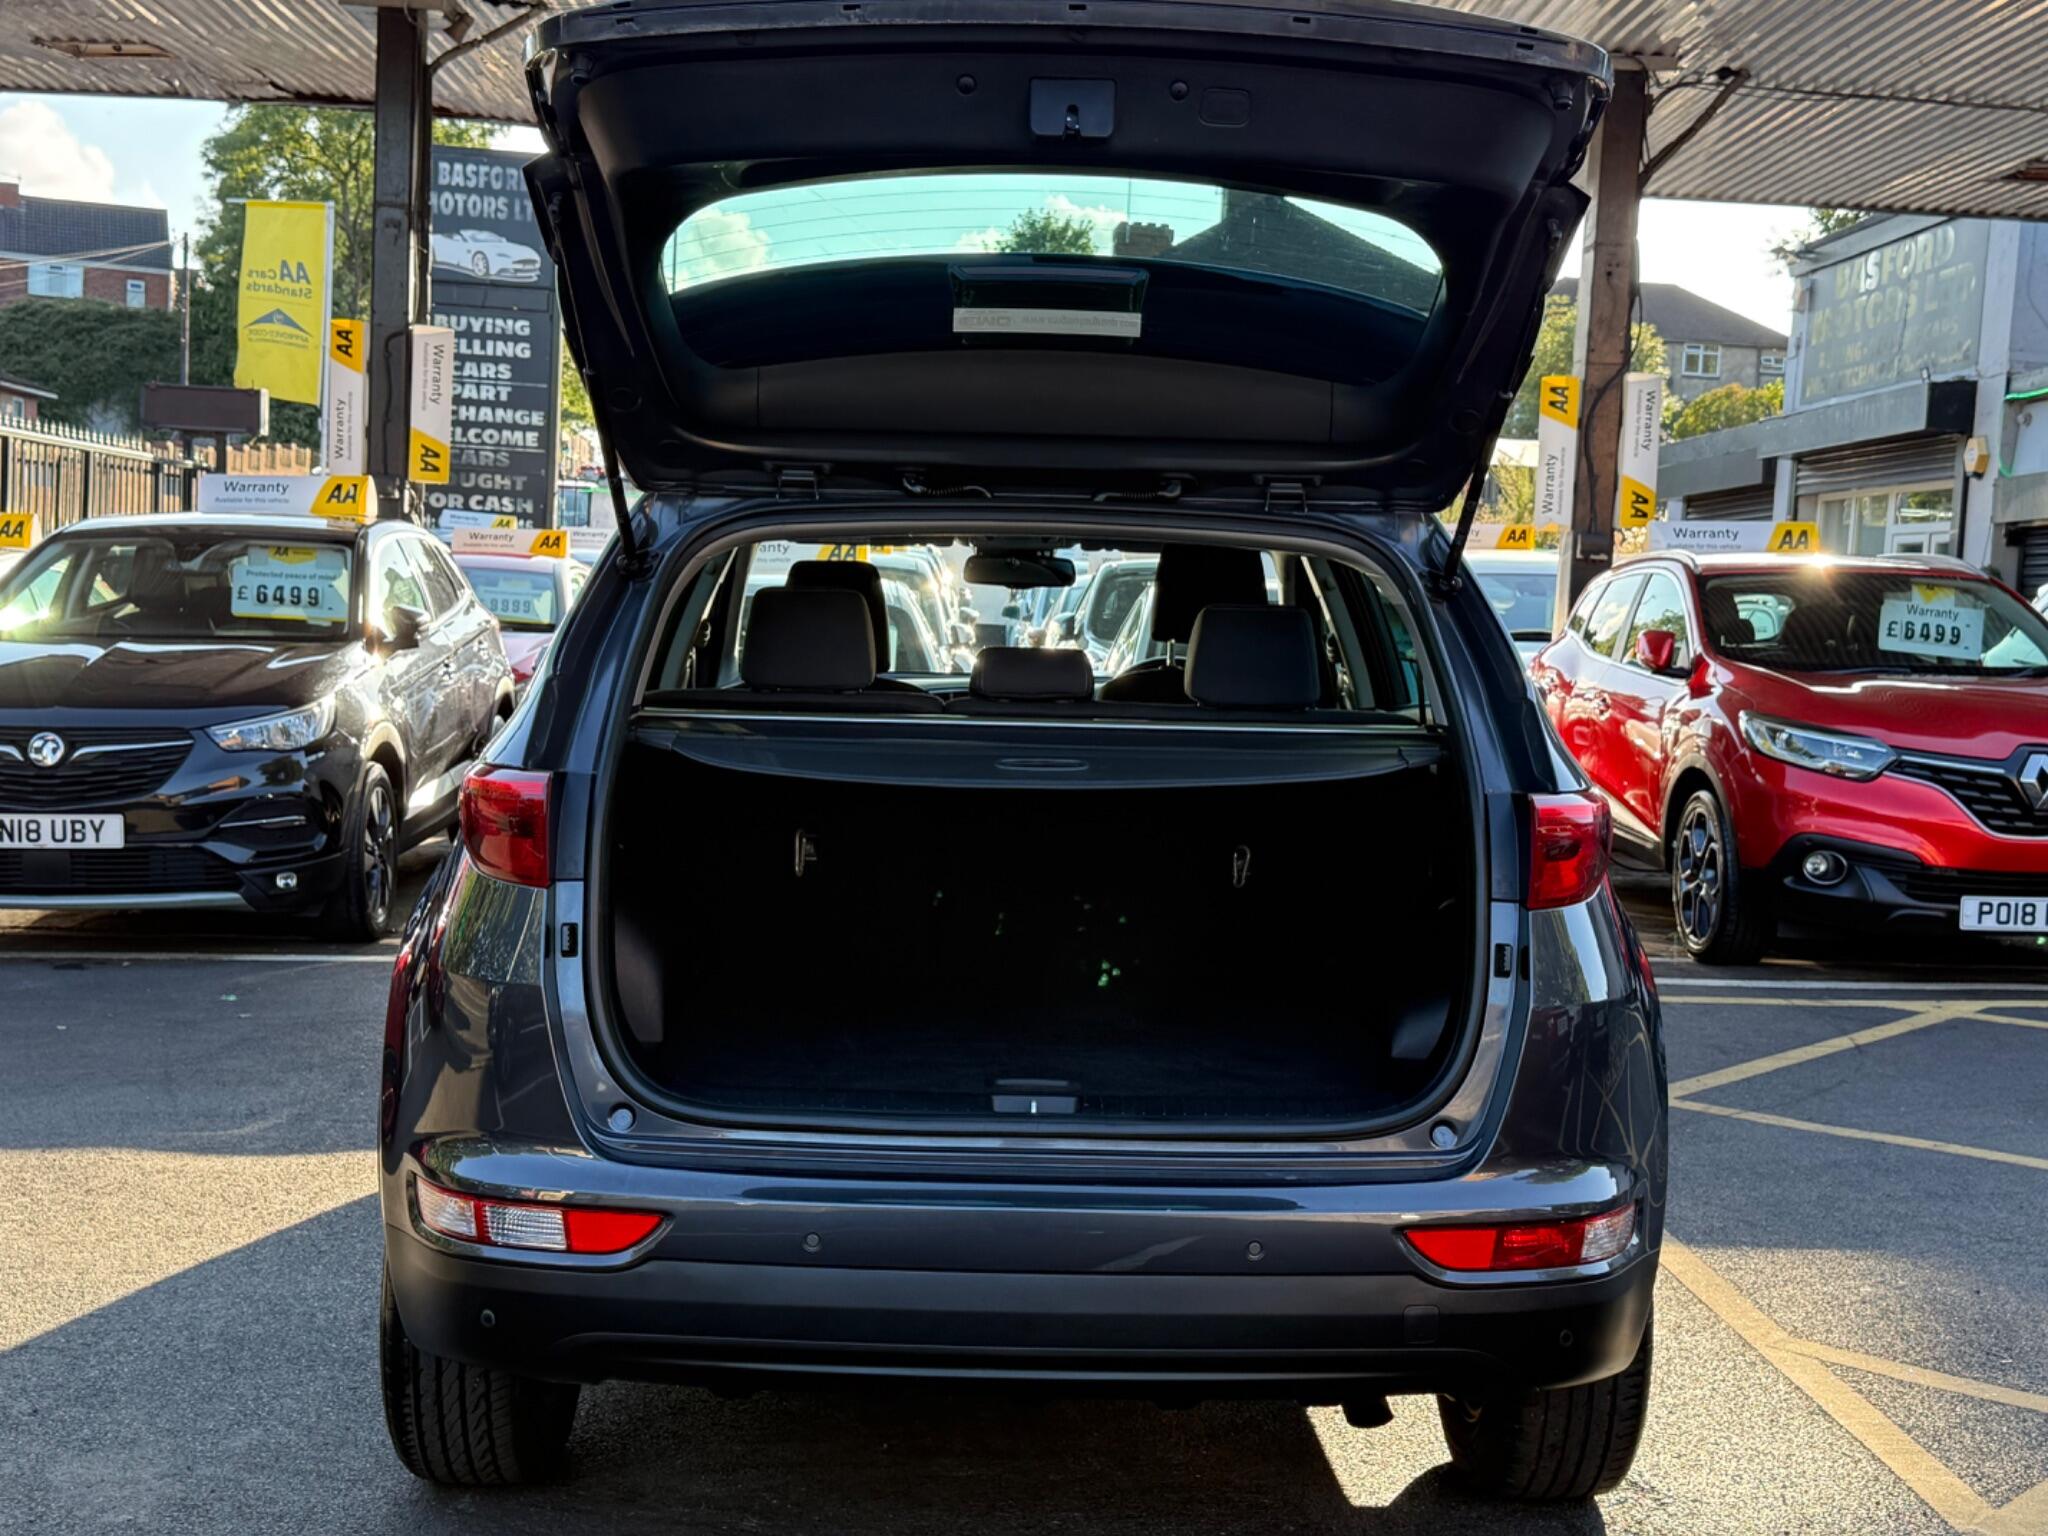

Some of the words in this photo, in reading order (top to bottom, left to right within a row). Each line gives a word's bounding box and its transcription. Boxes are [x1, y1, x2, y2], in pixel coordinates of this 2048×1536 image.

[336, 330, 353, 358] AA
[454, 338, 532, 359] LLING
[429, 344, 445, 405] Warranty
[1548, 385, 1570, 414] AA
[334, 399, 346, 459] Warranty
[1641, 390, 1656, 451] Warranty
[420, 443, 441, 472] AA
[224, 481, 290, 495] Warranty
[326, 483, 359, 504] AA
[1541, 454, 1558, 515] Warranty
[468, 494, 534, 514] CASH
[1631, 490, 1649, 518] AA
[0, 520, 25, 539] AA
[469, 532, 514, 543] Warranty
[539, 535, 560, 549] AA
[1505, 528, 1527, 542] AA
[1673, 527, 1740, 541] Warranty
[1777, 529, 1810, 550] AA
[1906, 603, 1959, 621] Warranty
[51, 819, 106, 843] UBY
